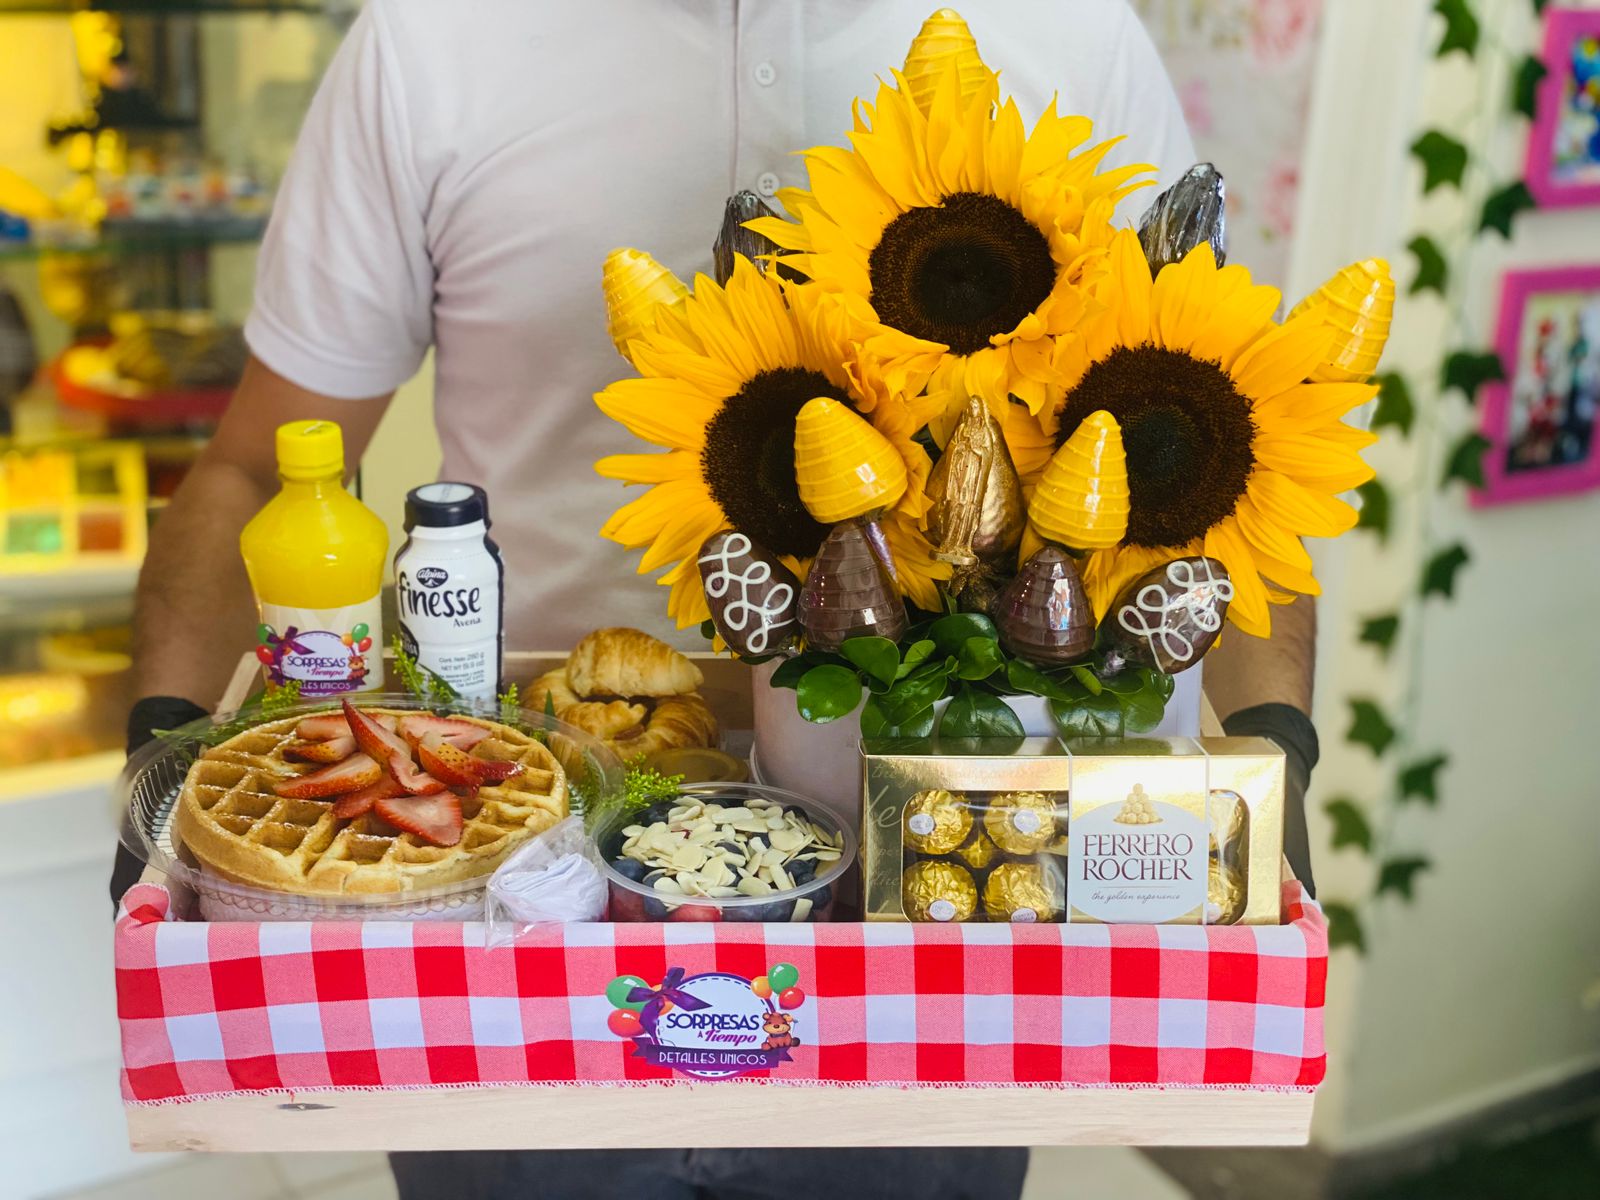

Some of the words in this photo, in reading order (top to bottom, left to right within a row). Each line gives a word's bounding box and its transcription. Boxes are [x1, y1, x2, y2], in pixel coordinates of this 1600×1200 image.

[399, 571, 481, 619] finesse
[453, 618, 481, 629] Avena
[287, 656, 346, 668] SORPRESAS
[1083, 833, 1193, 856] FERRERO
[1083, 858, 1192, 880] ROCHER
[1091, 890, 1104, 900] the
[1106, 890, 1134, 904] golden
[1136, 893, 1180, 904] experience
[666, 1013, 760, 1031] SORPRESAS
[697, 1031, 704, 1039] A
[704, 1028, 757, 1047] Tiempo
[658, 1051, 716, 1065] DETALLES
[720, 1053, 768, 1065] UNICOS
